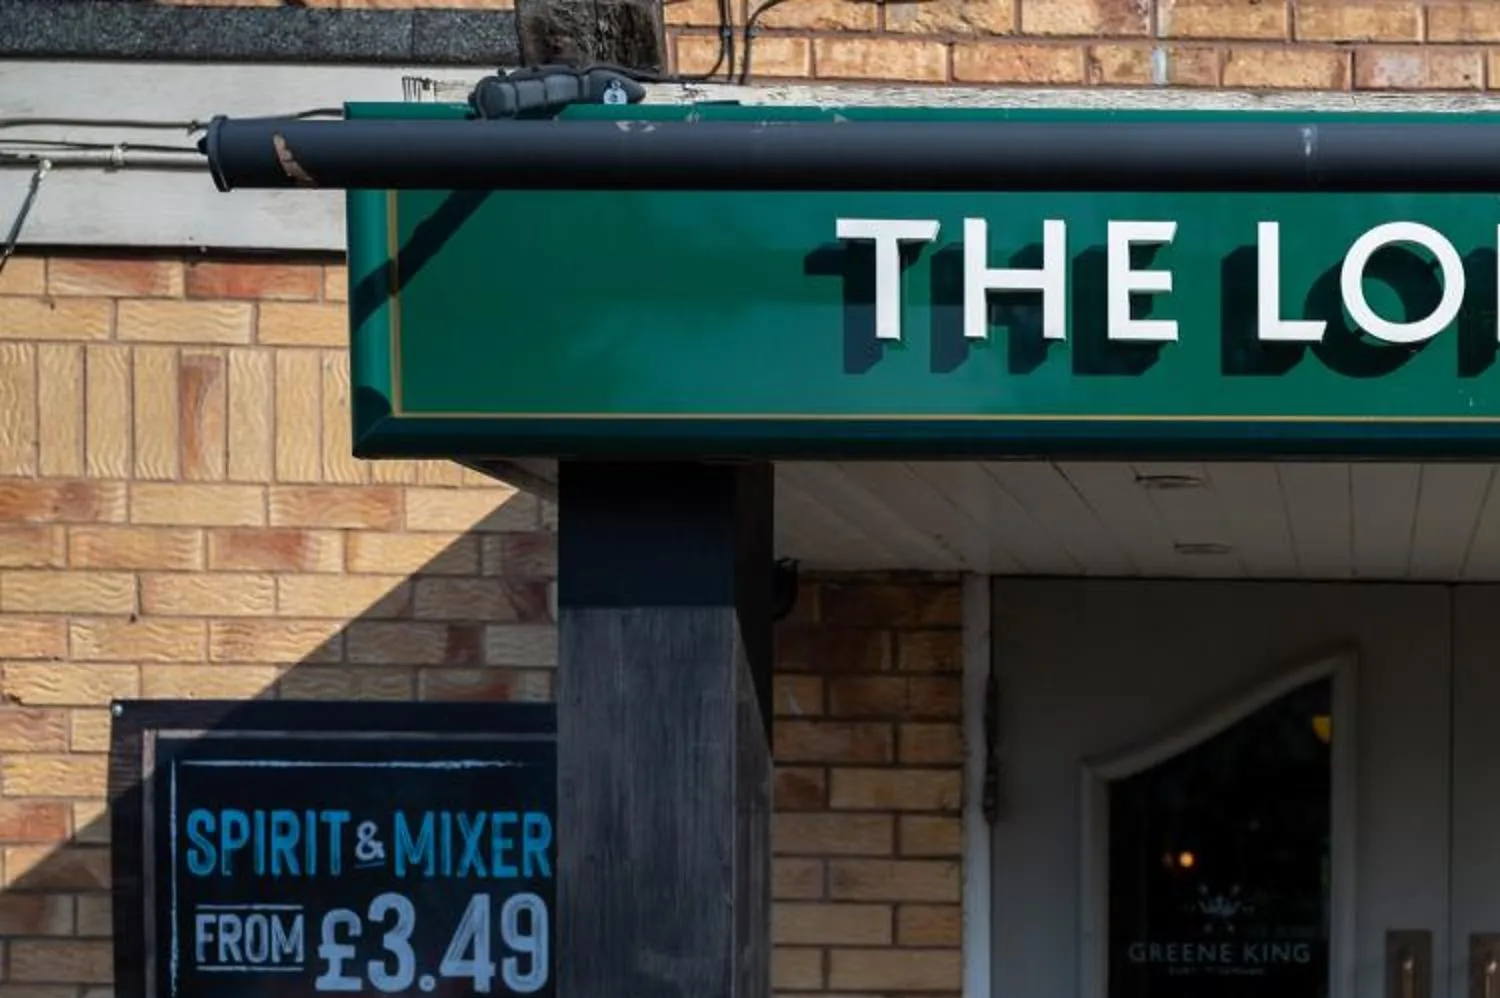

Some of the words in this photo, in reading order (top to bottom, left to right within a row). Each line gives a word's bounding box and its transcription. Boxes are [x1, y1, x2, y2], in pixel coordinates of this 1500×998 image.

[835, 217, 1180, 342] THE
[185, 808, 350, 878] SPIRIT
[354, 819, 386, 862] &
[393, 809, 554, 879] MIXER
[194, 912, 306, 963] FROM
[314, 891, 550, 994] £3.49
[1127, 942, 1234, 965] GREENE
[1242, 942, 1312, 965] KING
